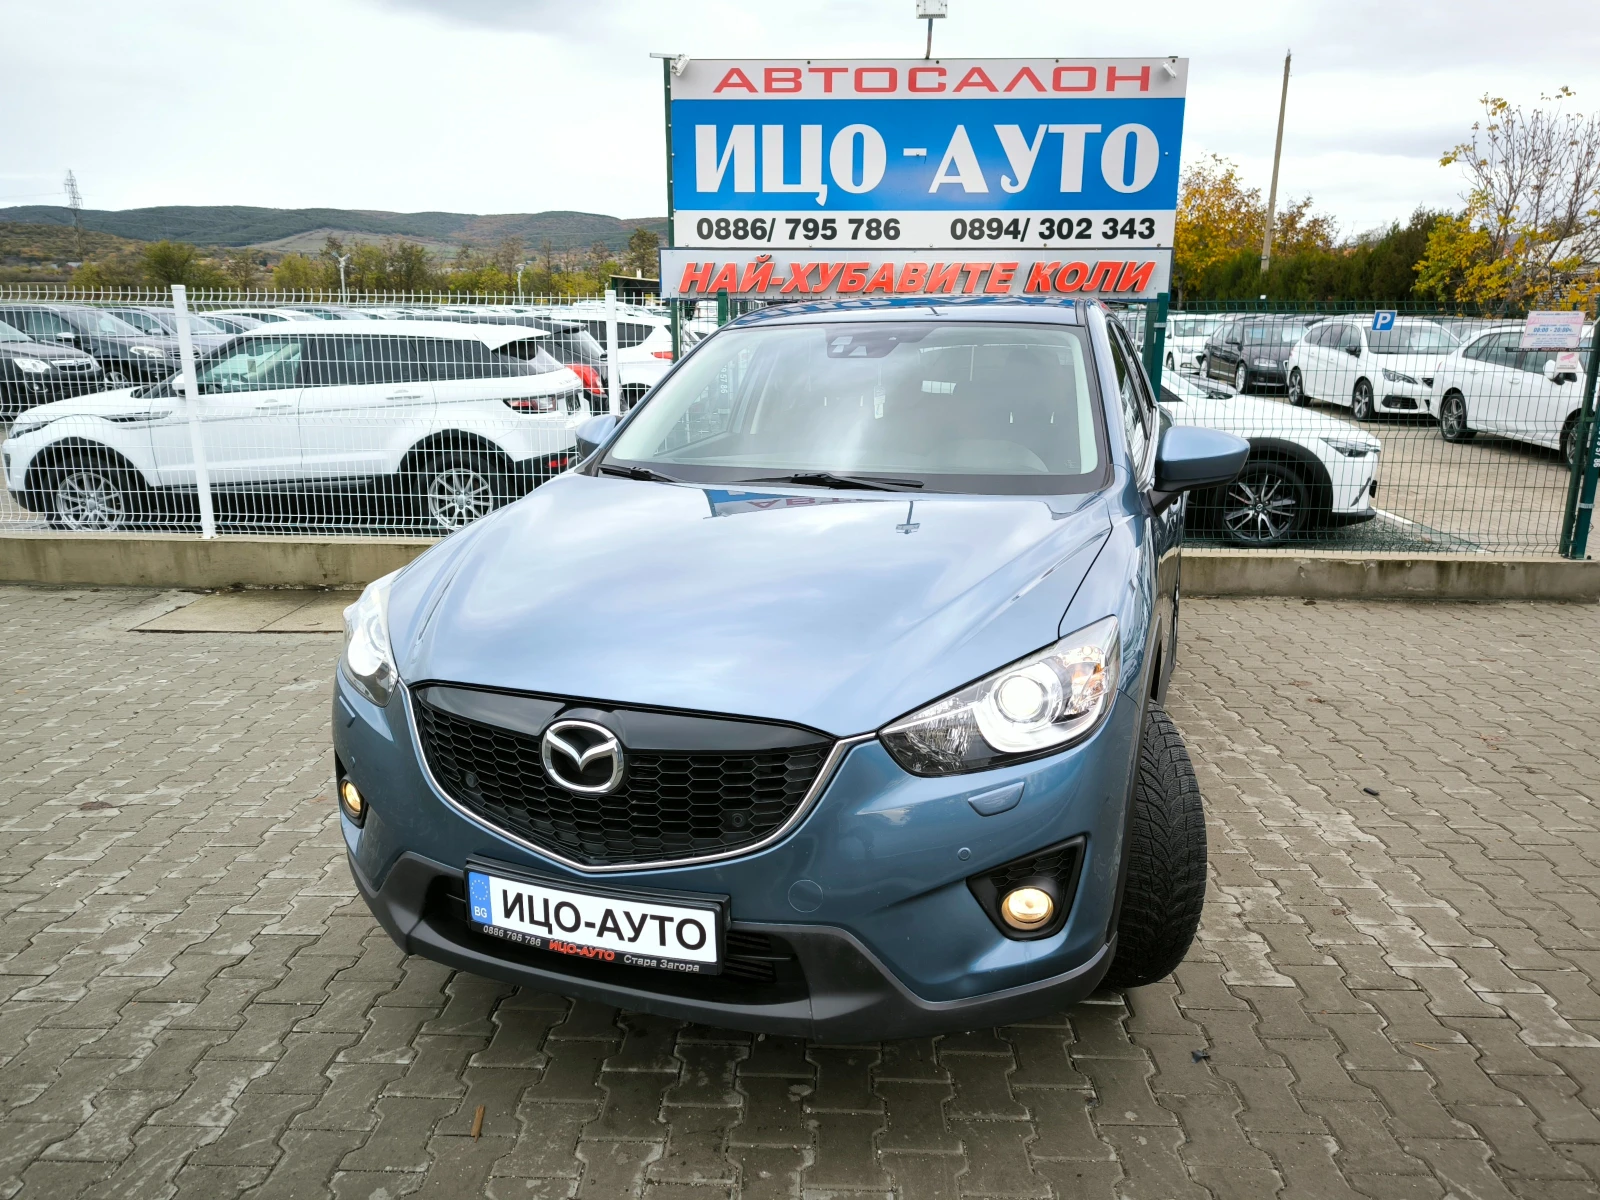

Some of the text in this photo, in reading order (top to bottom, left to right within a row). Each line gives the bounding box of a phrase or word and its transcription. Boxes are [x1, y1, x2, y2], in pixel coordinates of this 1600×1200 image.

[713, 66, 1150, 94] АВТОСАЛОН
[696, 217, 901, 243] 0886/ 795 786
[950, 217, 1155, 243] 0894/ 302 343
[678, 253, 1157, 294] НАЙ-ХУБАВИТЕ КОЛИ
[1375, 312, 1392, 330] P
[474, 905, 488, 919] BG
[502, 889, 707, 951] ИЦО-АУТО
[483, 925, 700, 973] 0886 795 786 ИЦО-АУТО Стара Загора
